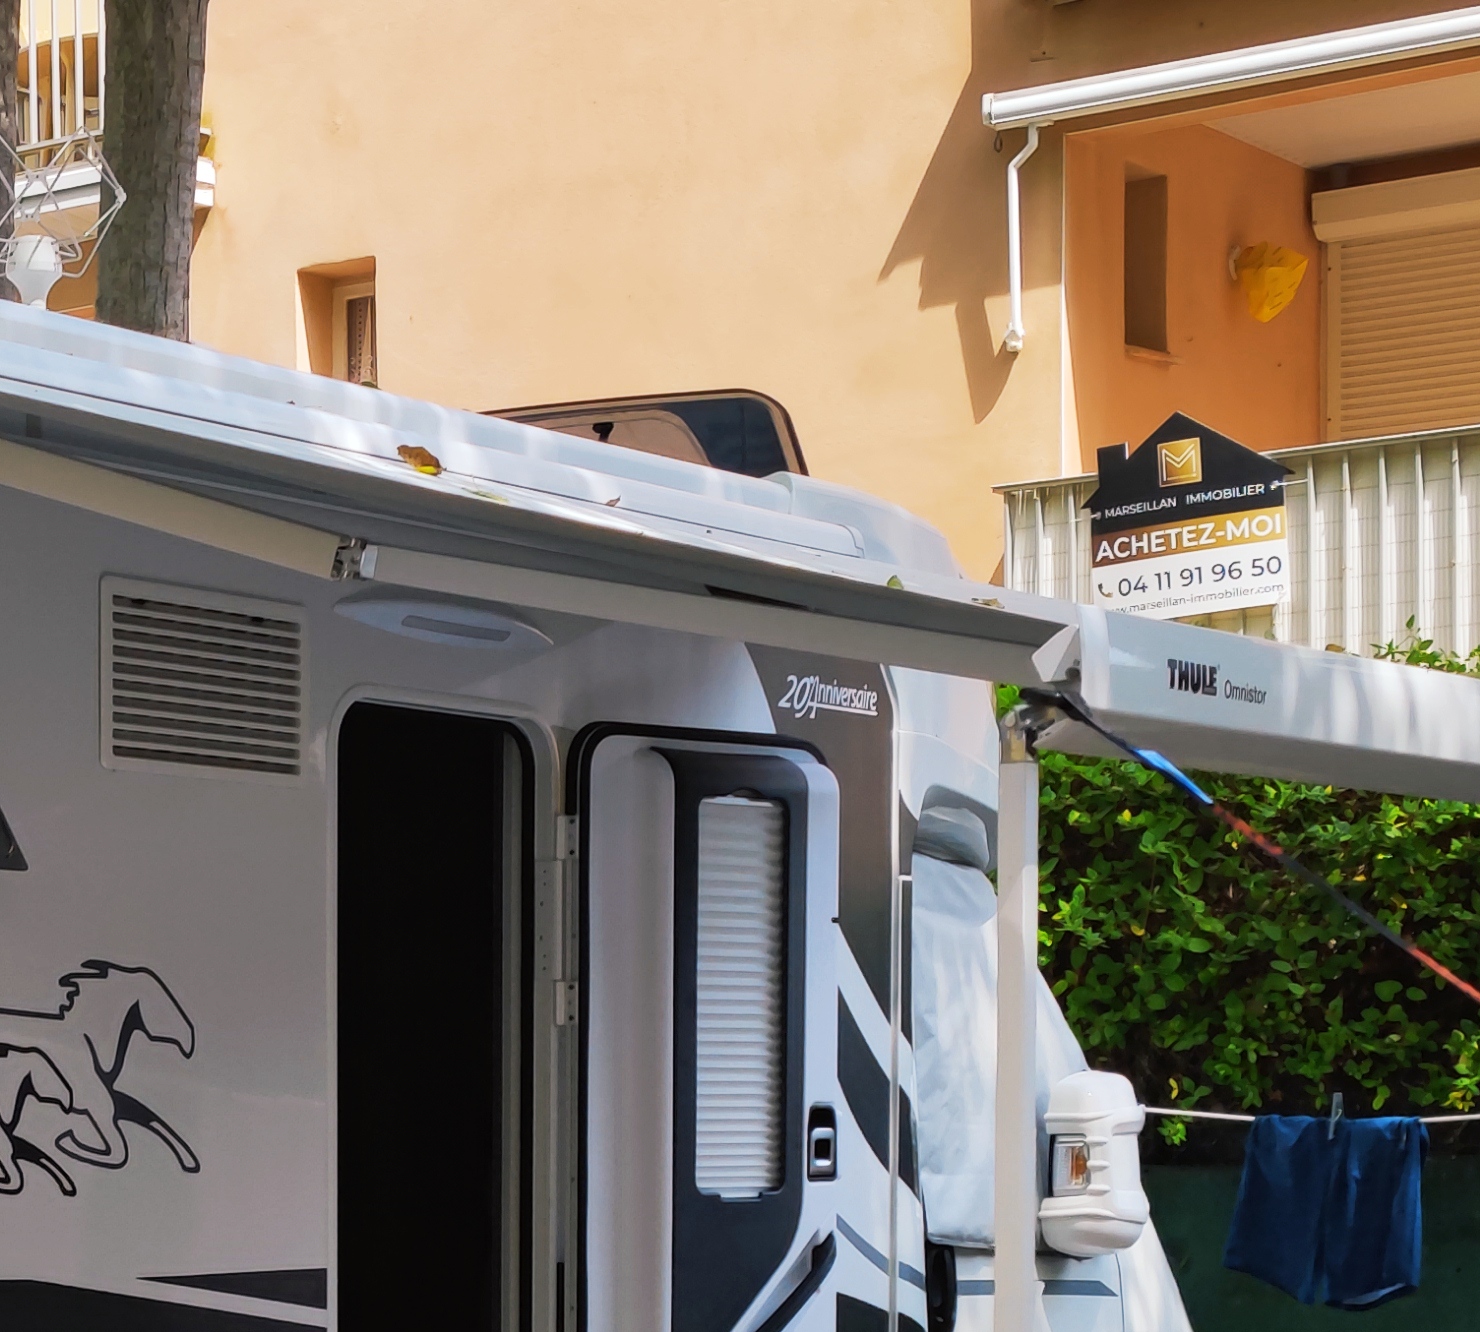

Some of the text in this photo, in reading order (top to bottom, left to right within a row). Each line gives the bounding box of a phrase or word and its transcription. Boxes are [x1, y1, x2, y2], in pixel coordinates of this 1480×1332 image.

[1104, 484, 1265, 519] MARSEILLAN IMMOBILIER
[1094, 513, 1283, 563] ACHETEZ-MOI
[1118, 555, 1282, 597] 04 11 91 96 50
[1167, 658, 1268, 704] THULE Omnistor
